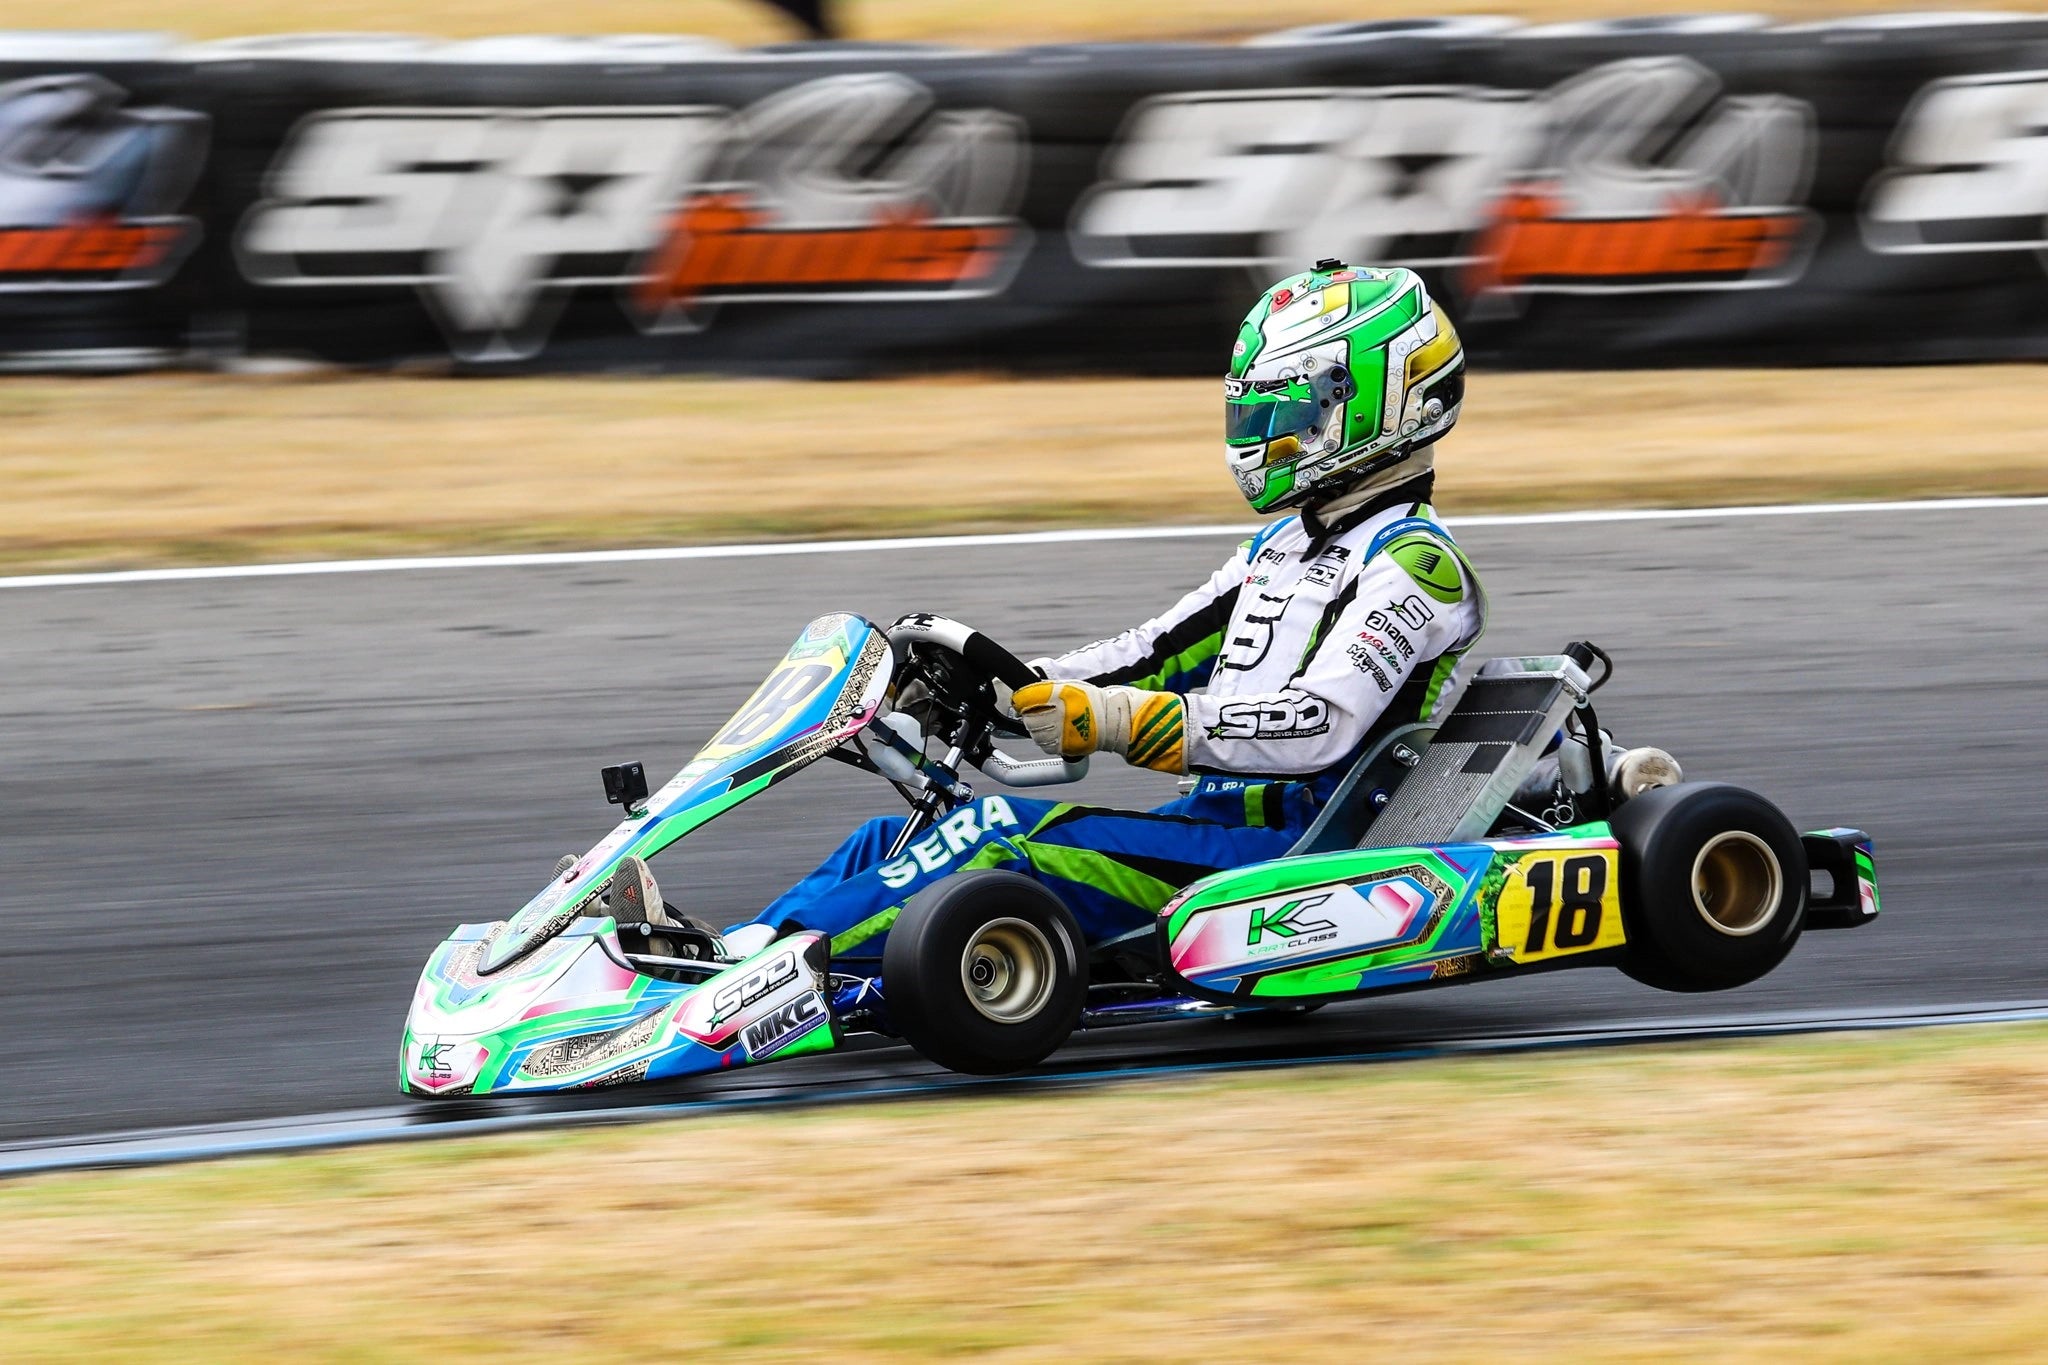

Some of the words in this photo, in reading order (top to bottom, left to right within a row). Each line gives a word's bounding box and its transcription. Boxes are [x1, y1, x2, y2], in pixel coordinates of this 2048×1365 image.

[1219, 696, 1329, 740] SDD
[877, 795, 1019, 889] SERA
[1247, 892, 1338, 946] KC
[1524, 854, 1608, 953] 18
[713, 950, 797, 1020] SDD
[745, 992, 819, 1052] MKC
[418, 1043, 456, 1071] KC
